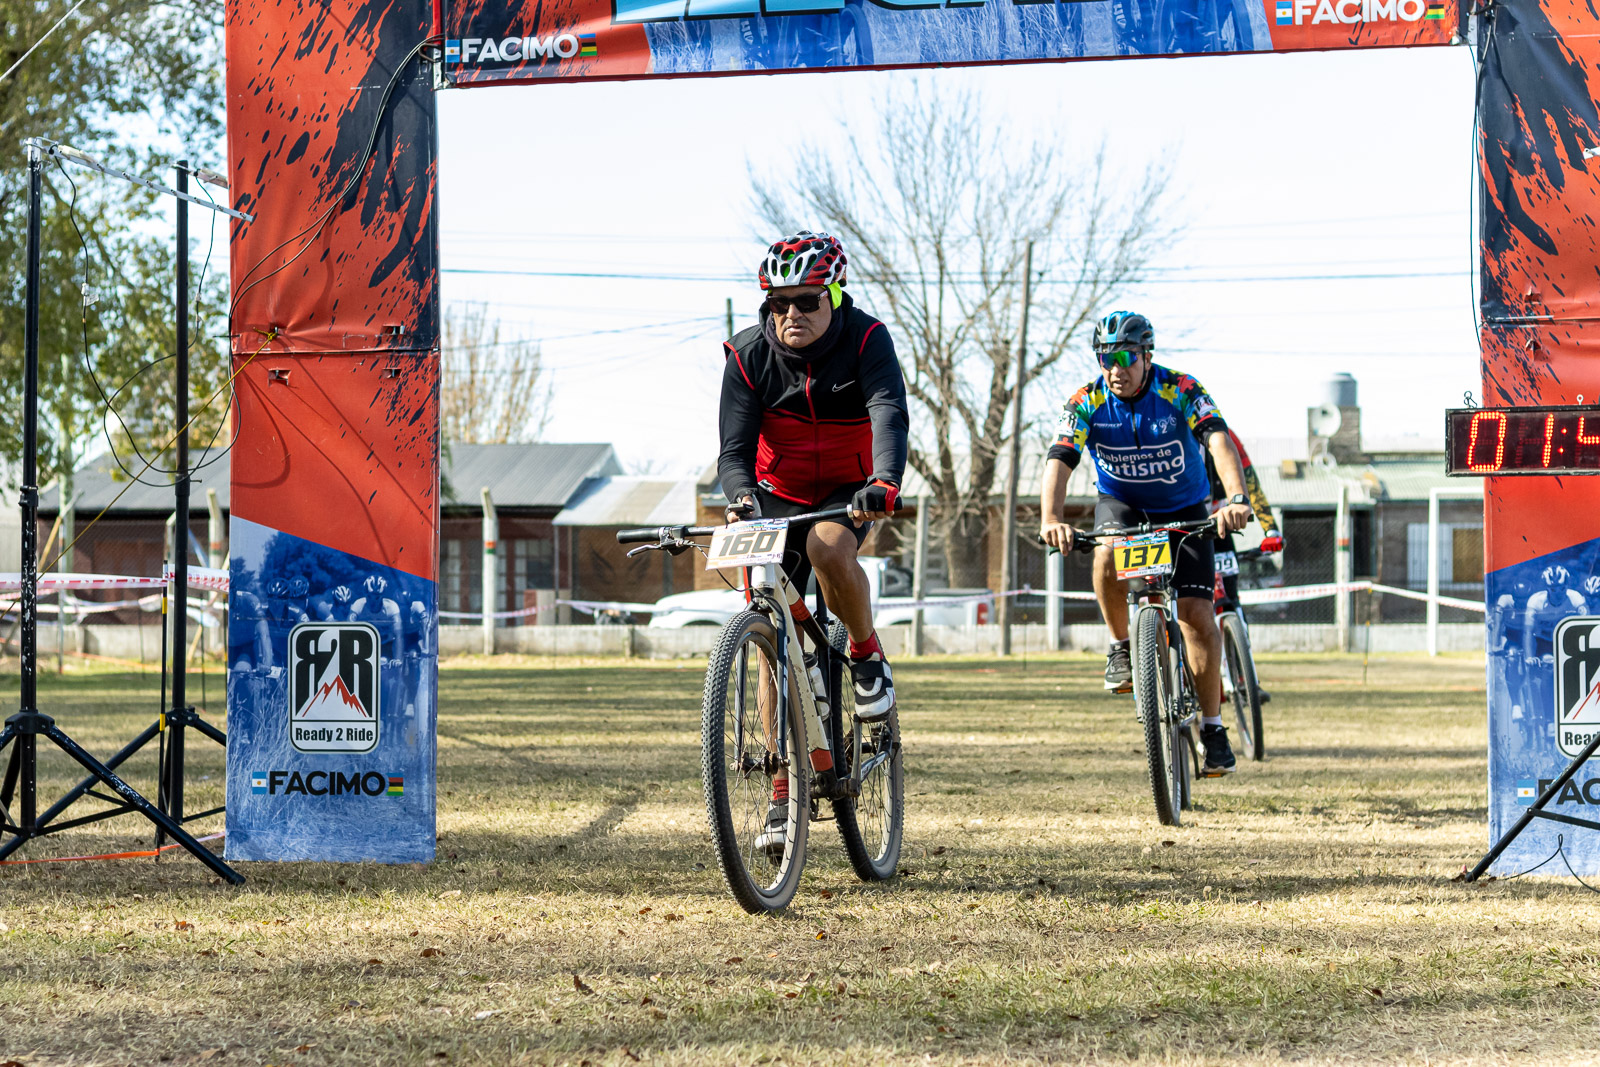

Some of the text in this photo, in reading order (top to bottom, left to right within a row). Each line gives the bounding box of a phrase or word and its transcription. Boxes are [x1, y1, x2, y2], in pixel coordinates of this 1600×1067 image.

[1295, 0, 1425, 25] FACIMO
[461, 34, 579, 63] FACIMO
[1156, 448, 1172, 458] de
[1098, 456, 1184, 477] autismo
[719, 531, 780, 557] 160
[1123, 543, 1166, 568] 137
[295, 727, 374, 743] Ready 2 Ride
[269, 770, 386, 797] FACIMO
